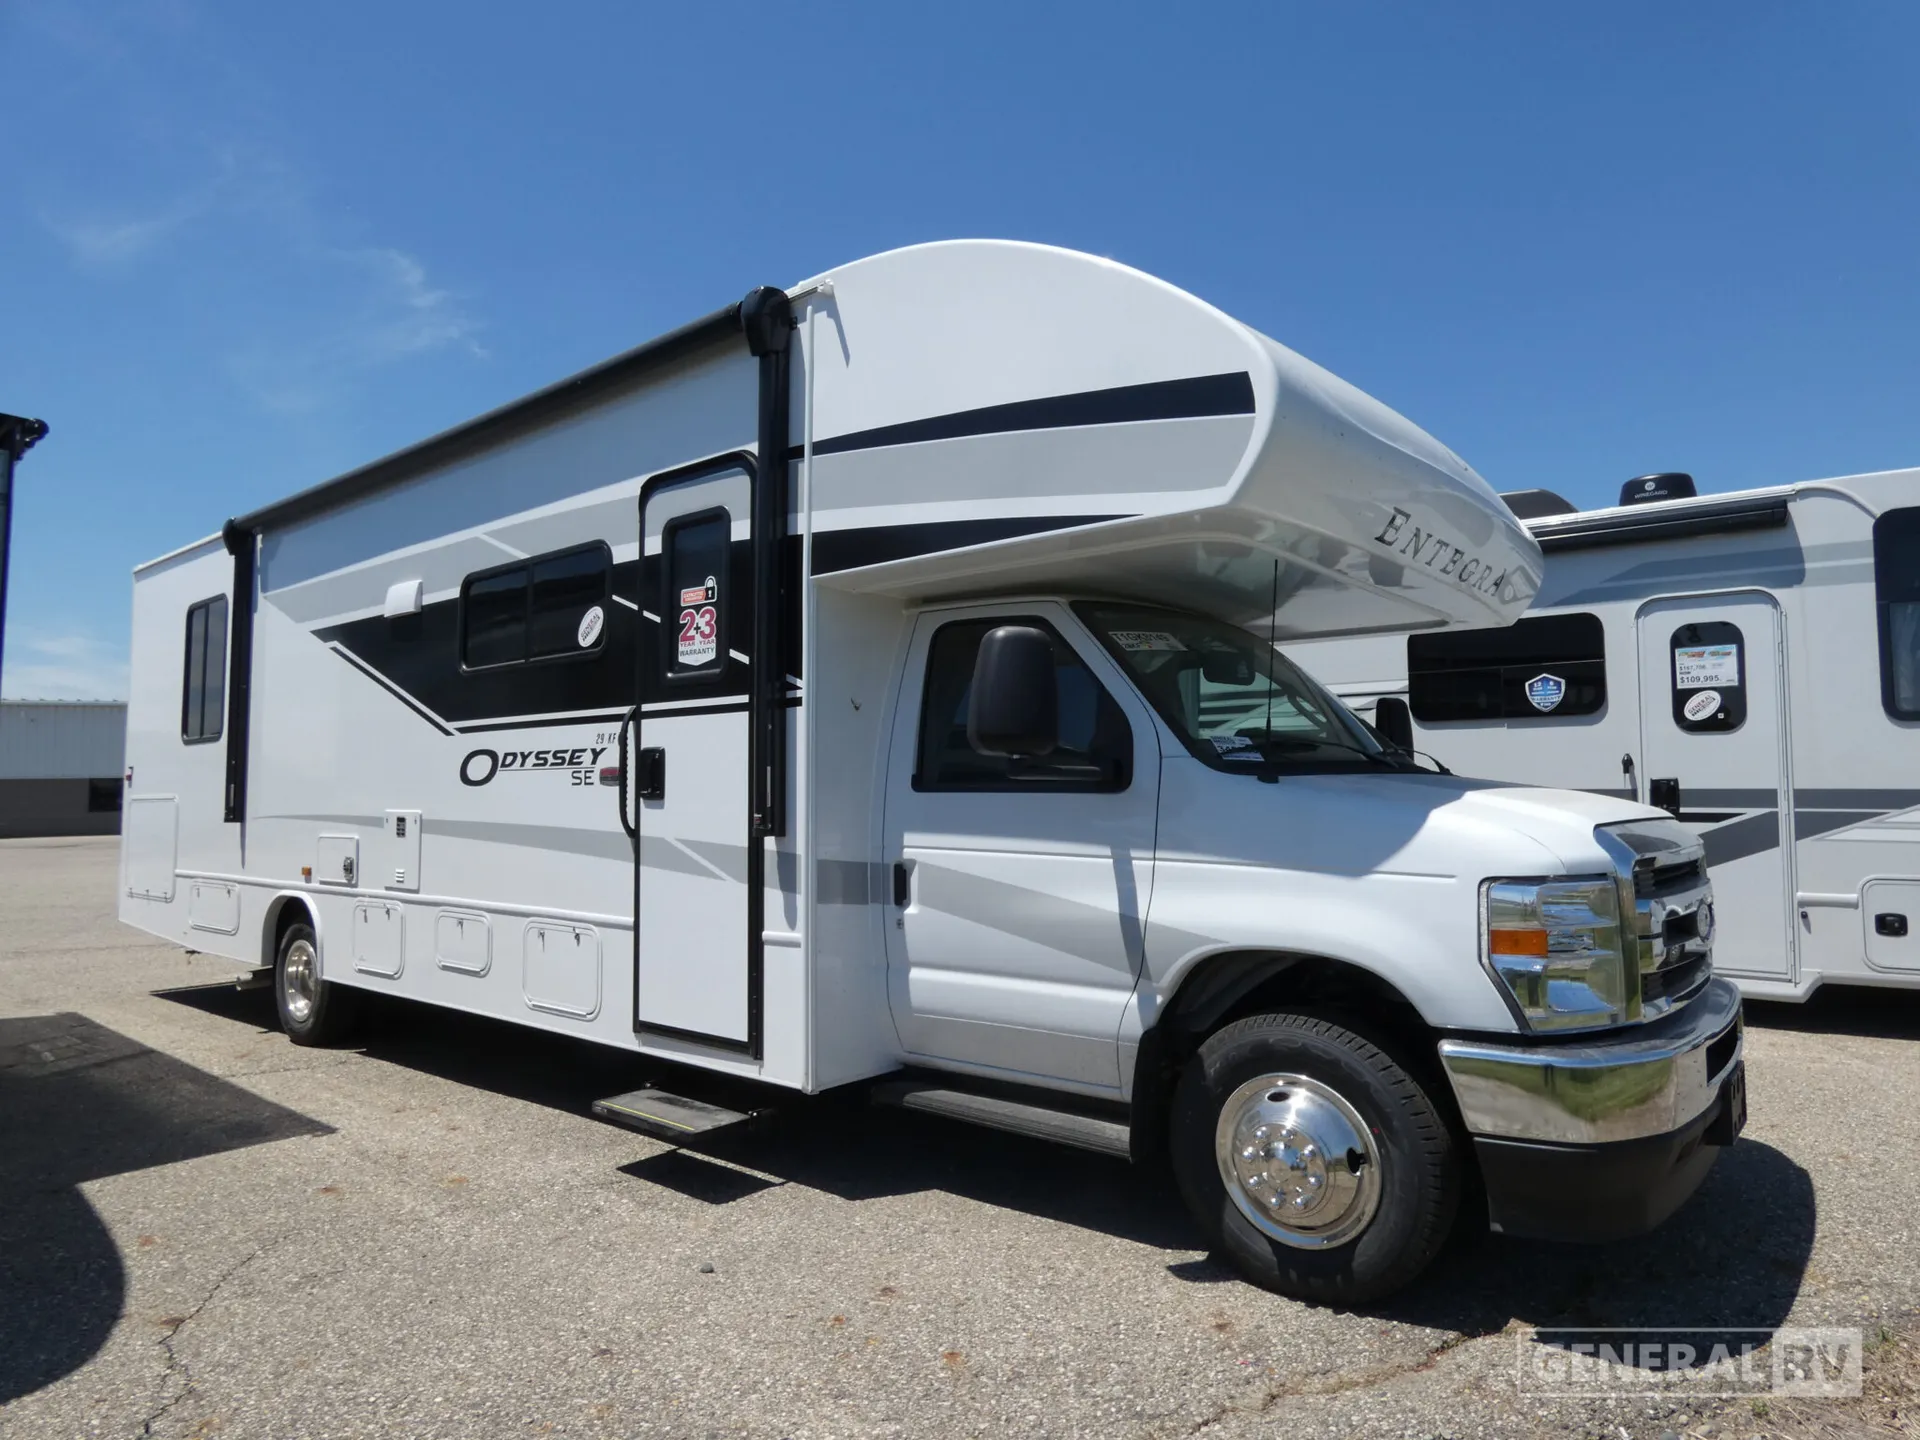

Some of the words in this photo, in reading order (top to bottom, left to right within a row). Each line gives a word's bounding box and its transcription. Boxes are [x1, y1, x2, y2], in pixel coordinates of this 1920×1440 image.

[1374, 506, 1507, 597] ENTEGRA
[680, 647, 715, 657] WARRANTY
[460, 747, 608, 787] ODYSSEY
[571, 770, 595, 786] SE
